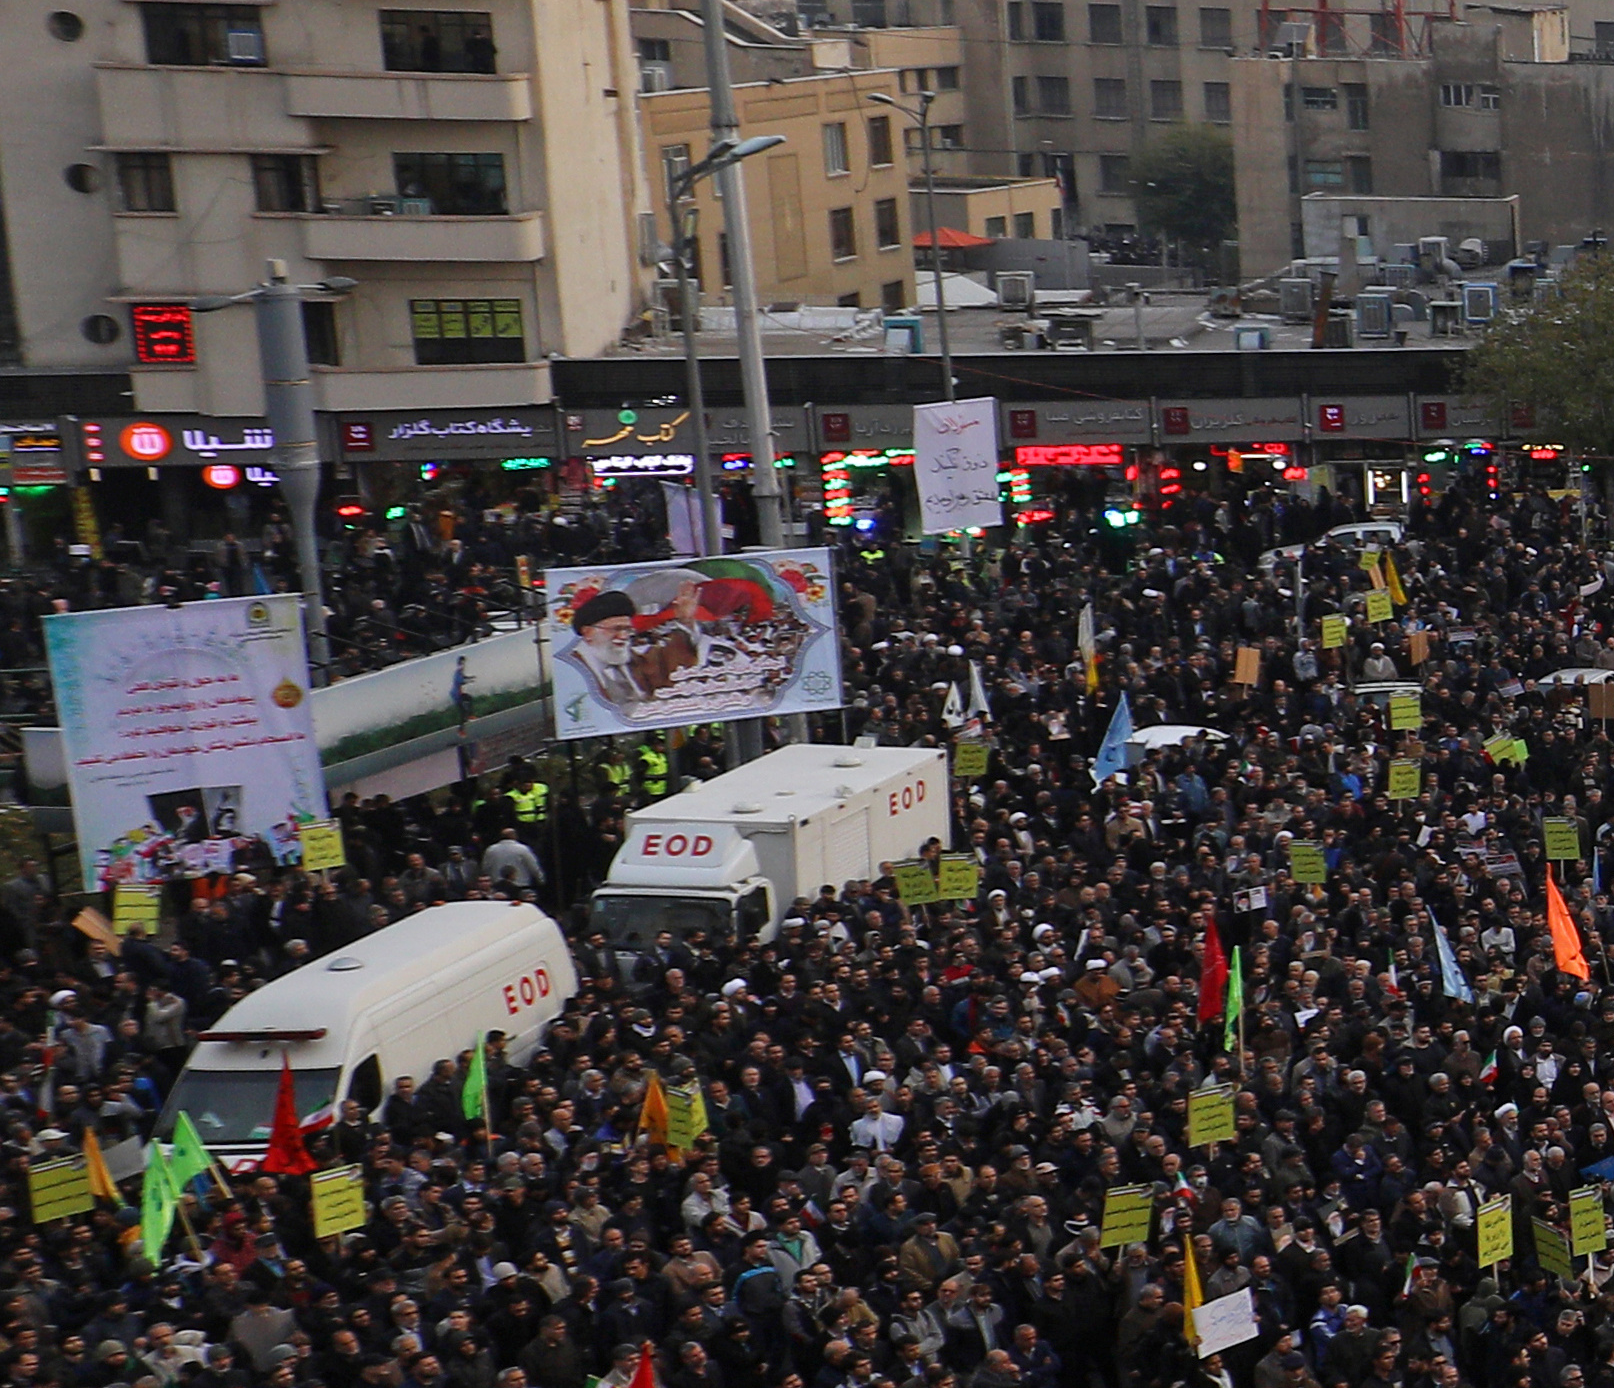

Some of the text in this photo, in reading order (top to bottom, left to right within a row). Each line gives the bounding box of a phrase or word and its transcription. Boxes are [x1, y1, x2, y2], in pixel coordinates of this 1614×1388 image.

[388, 417, 432, 439] گلزار
[432, 419, 478, 439] کتاب
[889, 779, 926, 816] EOD
[641, 834, 714, 857] EOD
[503, 968, 551, 1015] EOD
